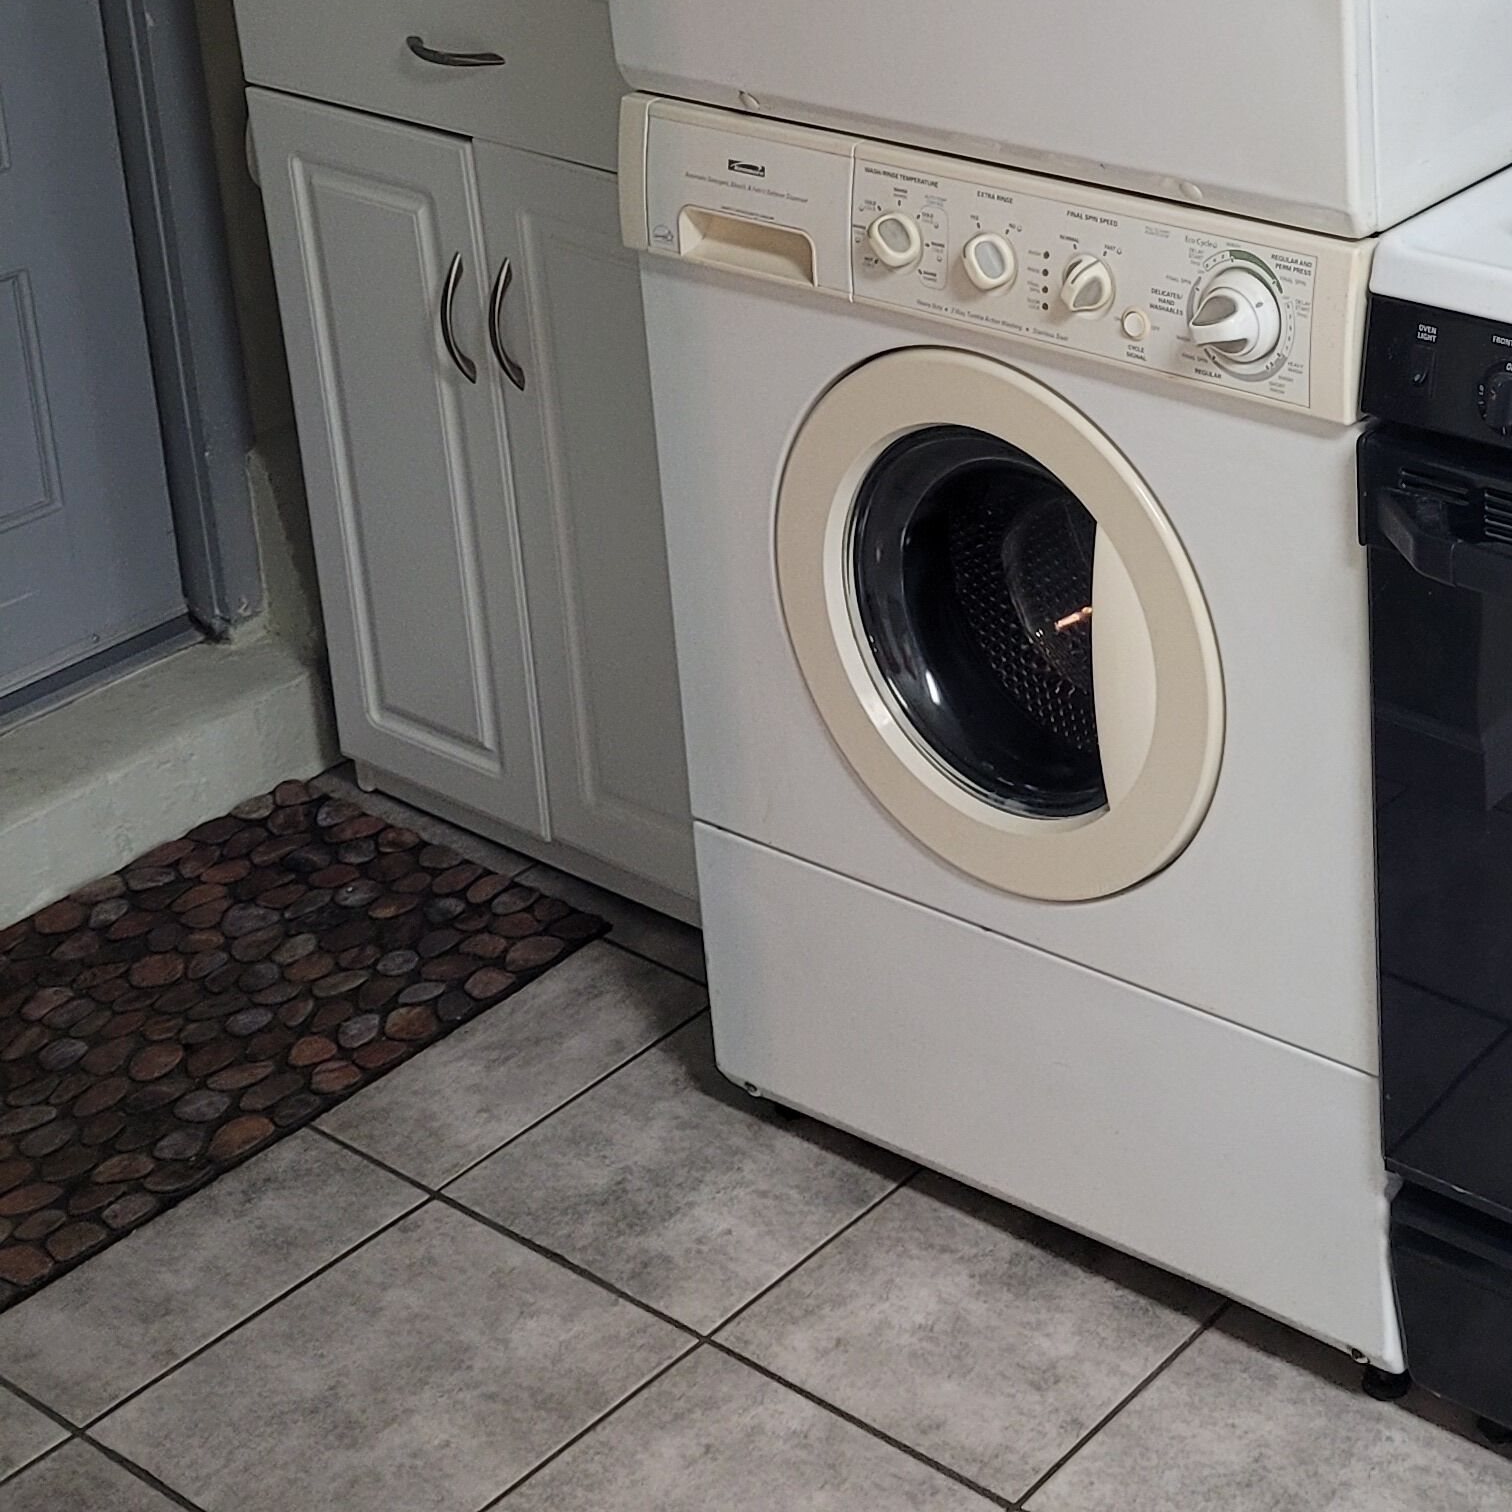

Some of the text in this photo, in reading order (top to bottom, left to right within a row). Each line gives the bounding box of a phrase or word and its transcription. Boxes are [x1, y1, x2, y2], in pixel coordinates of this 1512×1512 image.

[899, 174, 938, 189] TEMPERATURE
[977, 190, 1013, 204] EXTRA RINSE
[1066, 210, 1118, 227] FINAL SPIN SPEED
[1184, 235, 1213, 248] Eco Cycle
[1271, 253, 1313, 268] REGULAR AND
[1275, 262, 1312, 277] PERM PRESS
[1158, 296, 1175, 306] HAND
[1149, 303, 1183, 316] WASHABLES
[1418, 324, 1437, 335] OVEN
[1417, 332, 1437, 343] LIGHT
[1128, 345, 1144, 354] CYCLE
[1194, 368, 1222, 379] REGULAR
